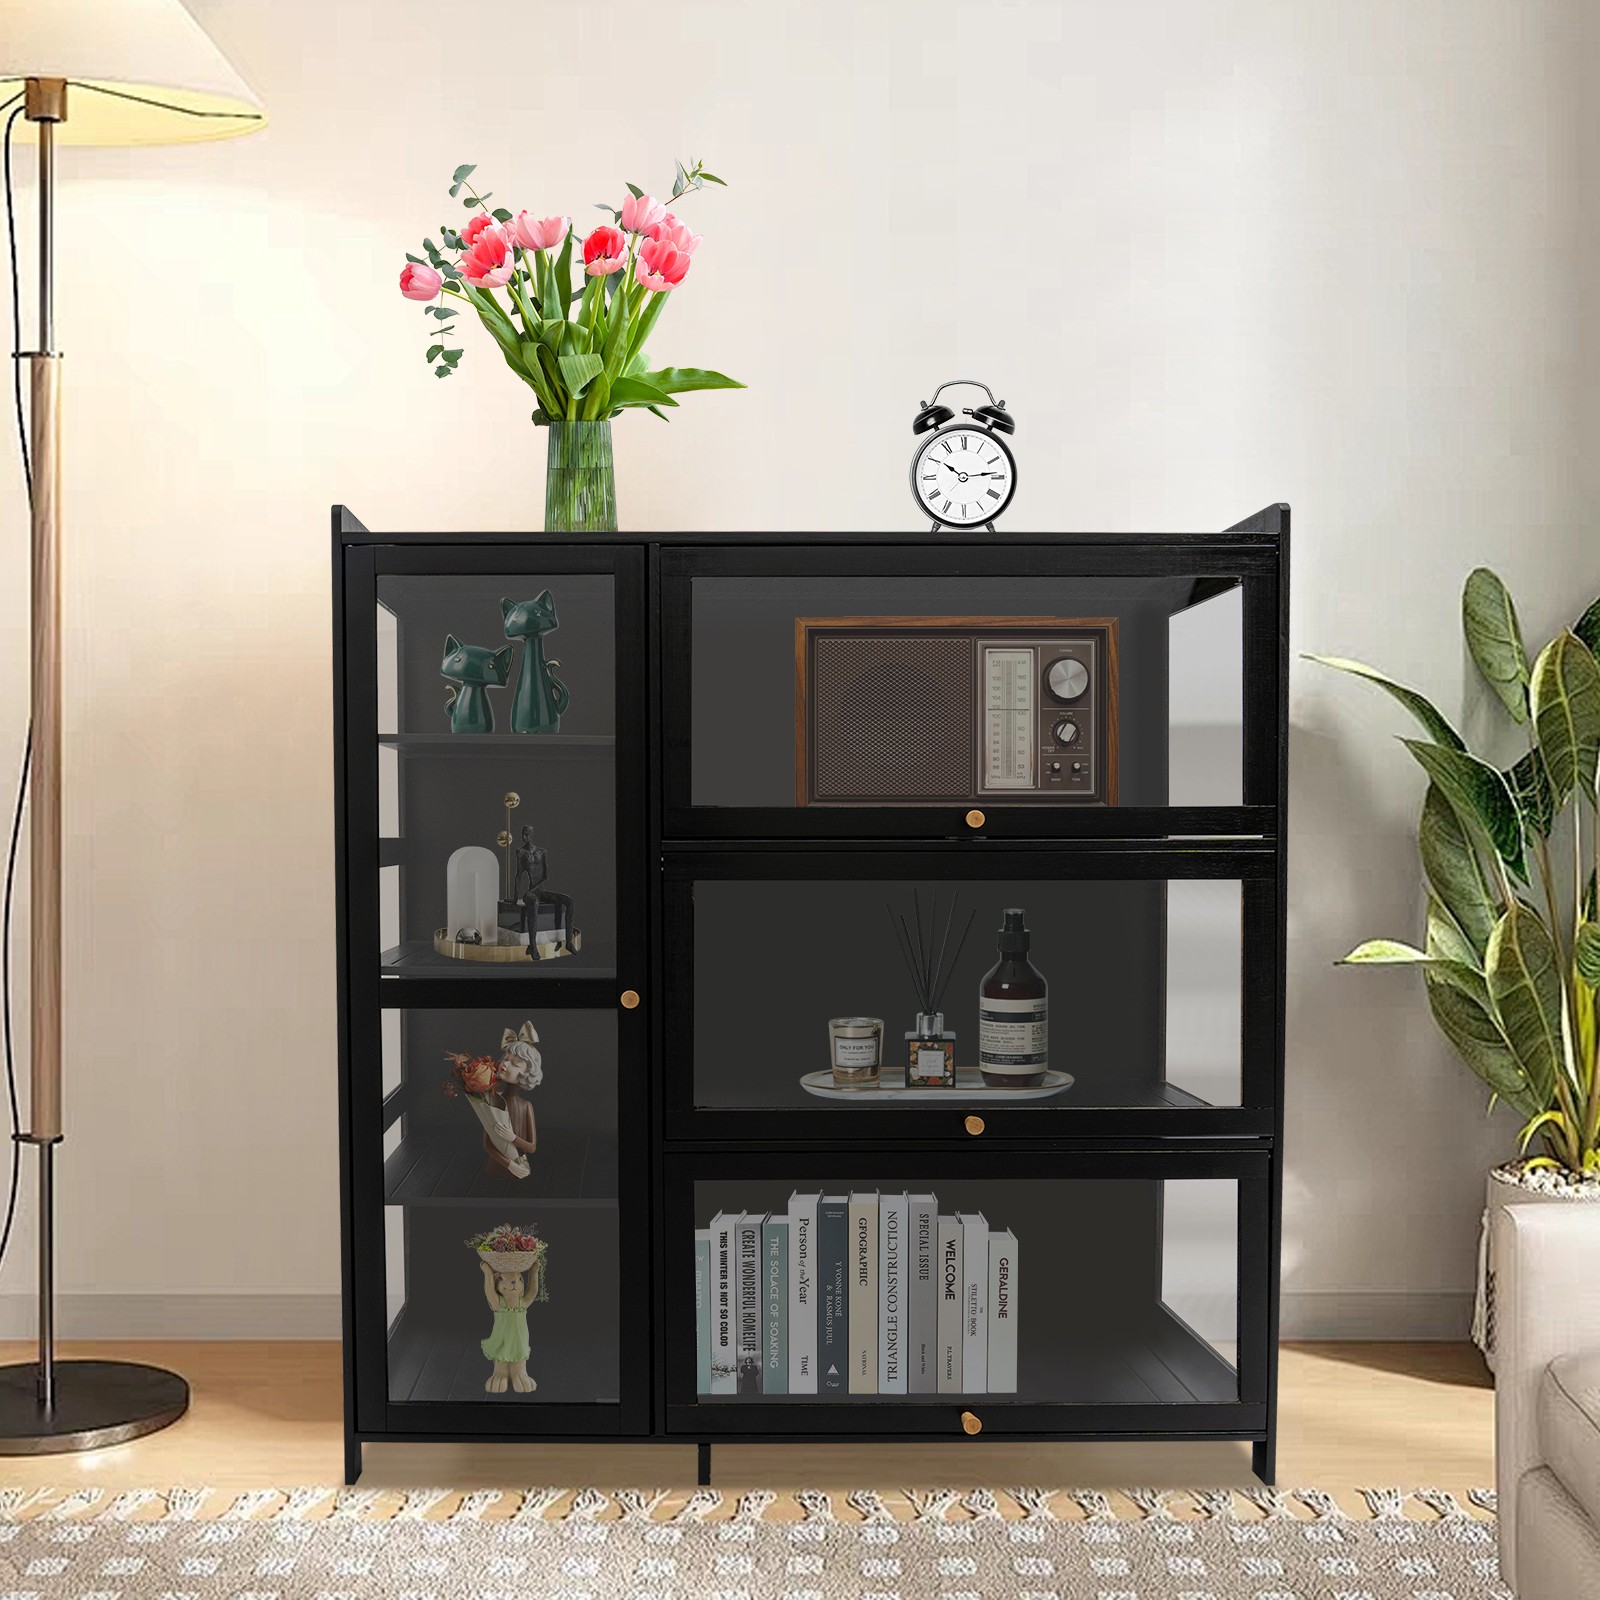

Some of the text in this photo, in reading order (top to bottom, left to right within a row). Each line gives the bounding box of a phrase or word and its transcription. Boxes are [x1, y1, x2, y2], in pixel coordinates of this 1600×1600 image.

[719, 1231, 728, 1248] THIS
[799, 1218, 809, 1258] Person
[919, 1214, 929, 1280] SPECIAL ISSUE
[719, 1250, 728, 1279] WINTER
[945, 1239, 956, 1300] WELCOME
[719, 1282, 728, 1290] IS
[719, 1292, 728, 1307] NOT
[741, 1229, 756, 1352] CREATE WONDERFUL HOMELIFE
[769, 1237, 779, 1369] THE SOLACE OF SOAKING
[799, 1279, 809, 1305] Year
[887, 1211, 898, 1382] TRIANGLE CONSTRUCTION
[998, 1257, 1009, 1319] GERALDINE
[719, 1309, 728, 1320] SO
